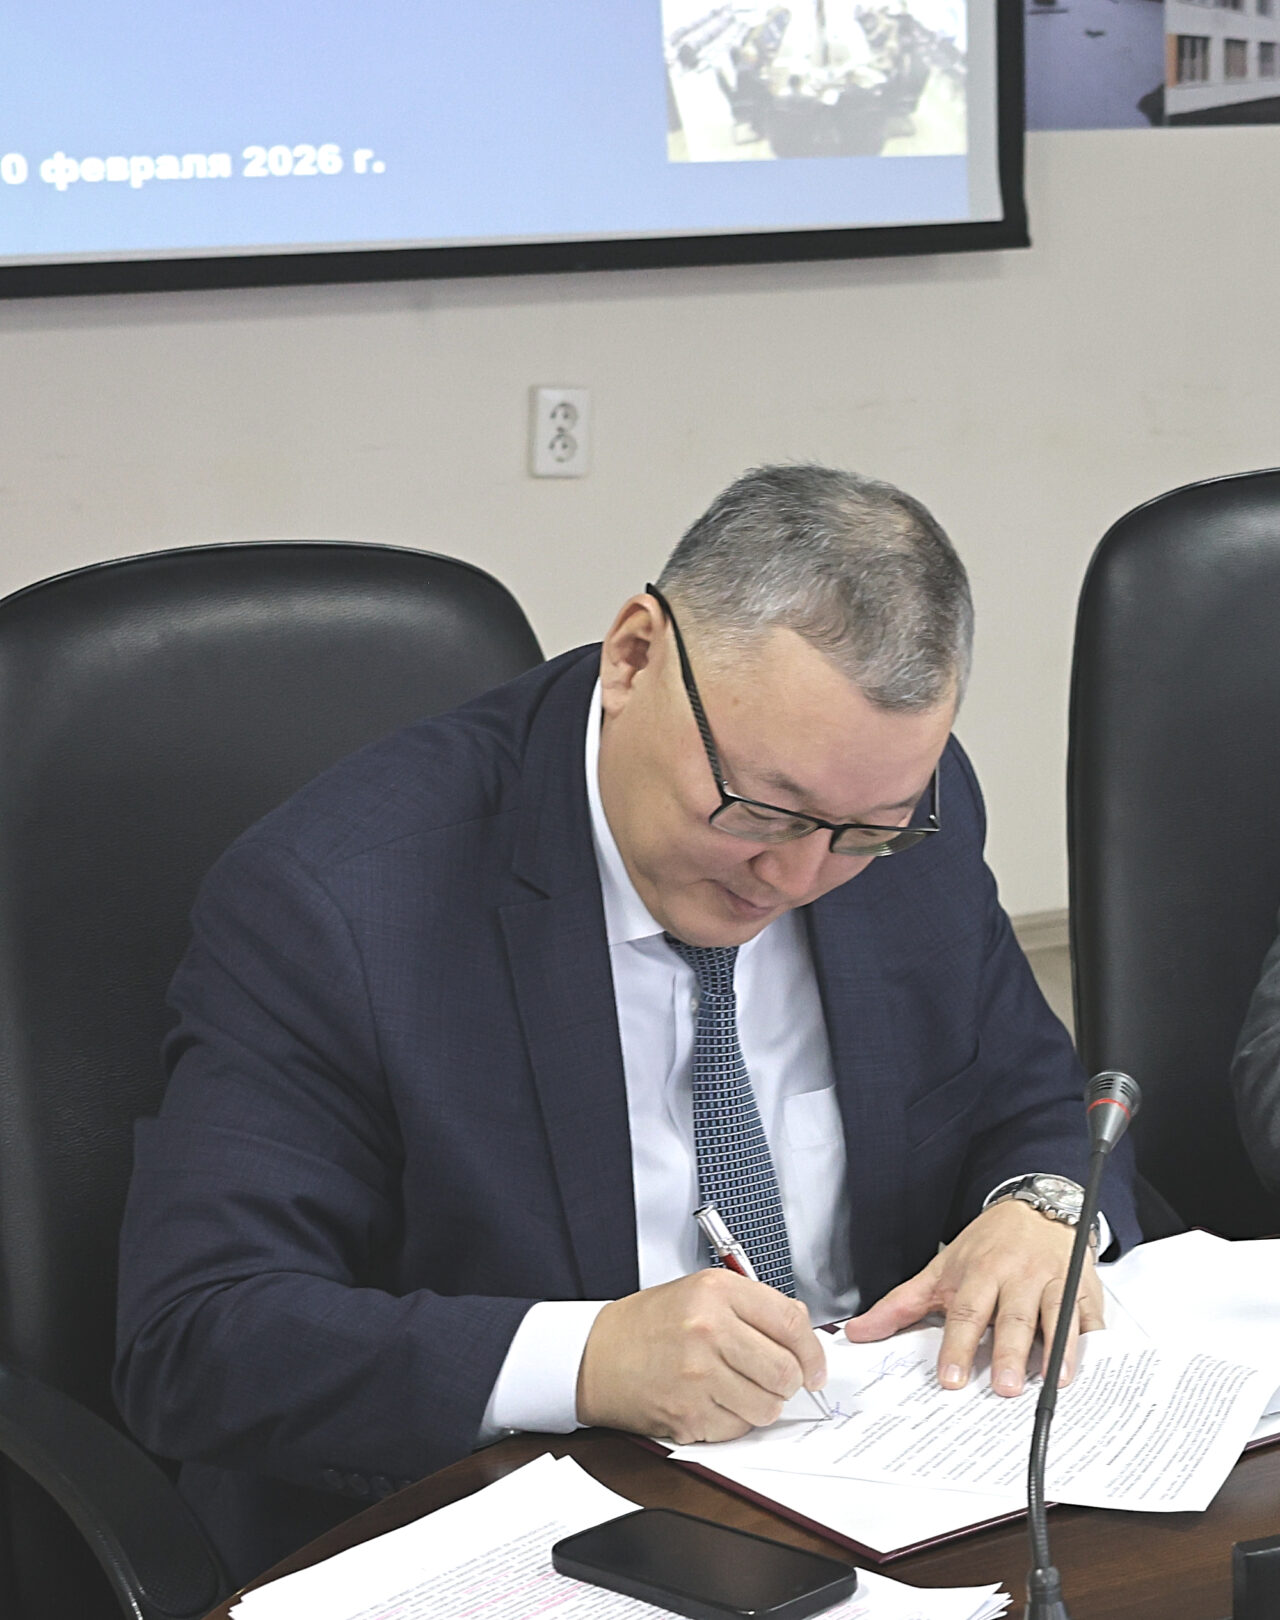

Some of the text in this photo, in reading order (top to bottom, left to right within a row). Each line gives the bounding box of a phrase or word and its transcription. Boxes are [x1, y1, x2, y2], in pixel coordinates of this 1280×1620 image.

[40, 150, 232, 191] февраля
[242, 143, 343, 178] 2026
[353, 148, 386, 174] г.
